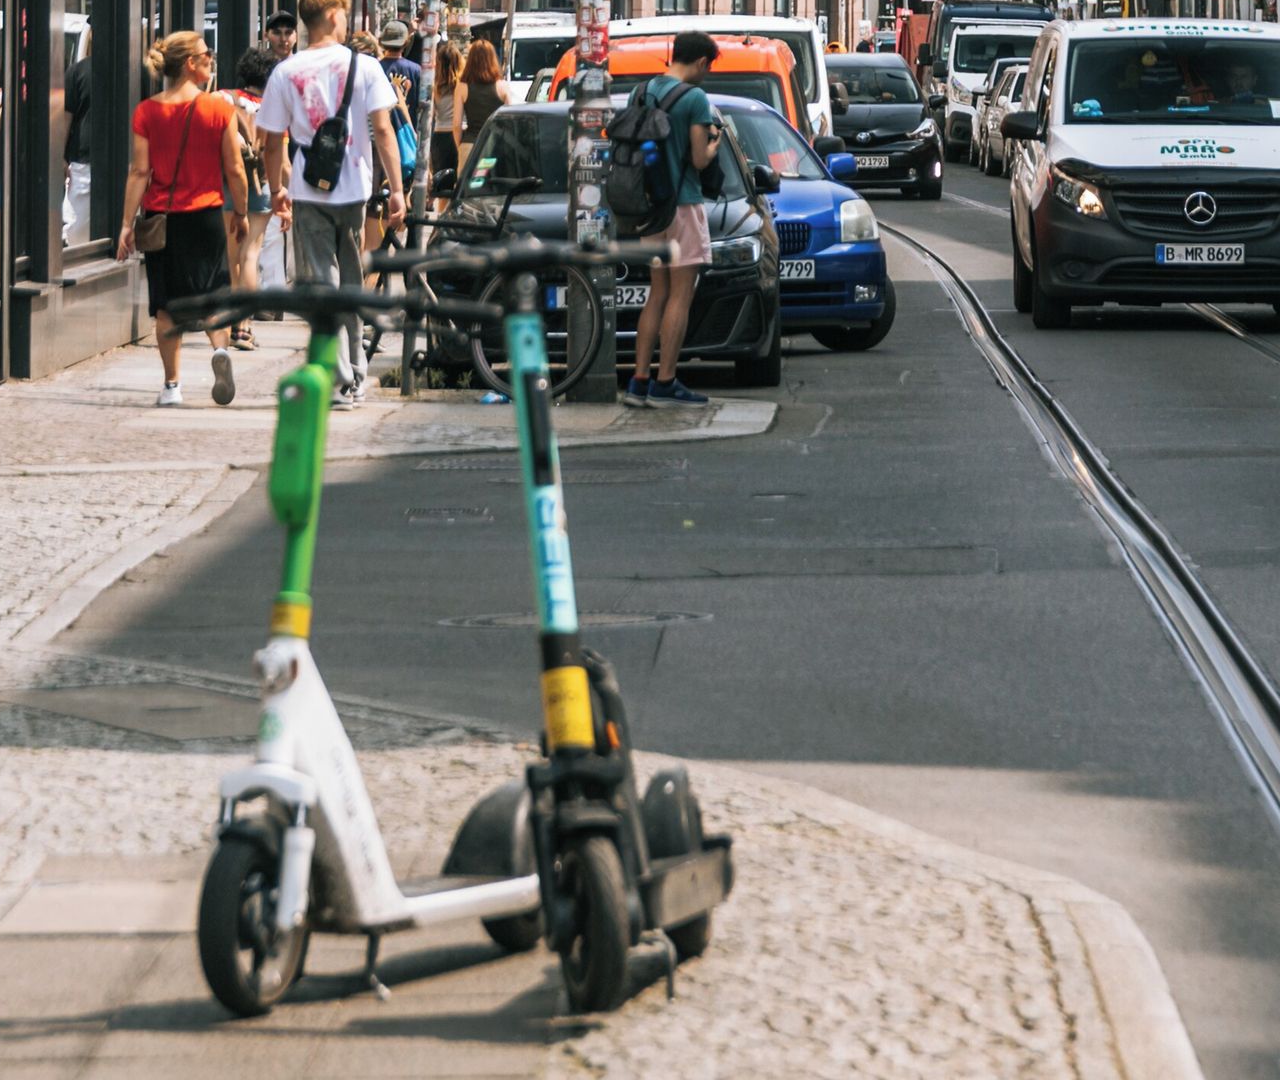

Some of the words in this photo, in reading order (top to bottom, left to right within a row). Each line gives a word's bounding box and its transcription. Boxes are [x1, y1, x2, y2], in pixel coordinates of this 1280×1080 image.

[1166, 247, 1175, 261] B
[1185, 247, 1204, 261] MR
[1207, 247, 1243, 261] 8699
[778, 261, 813, 278] 2799
